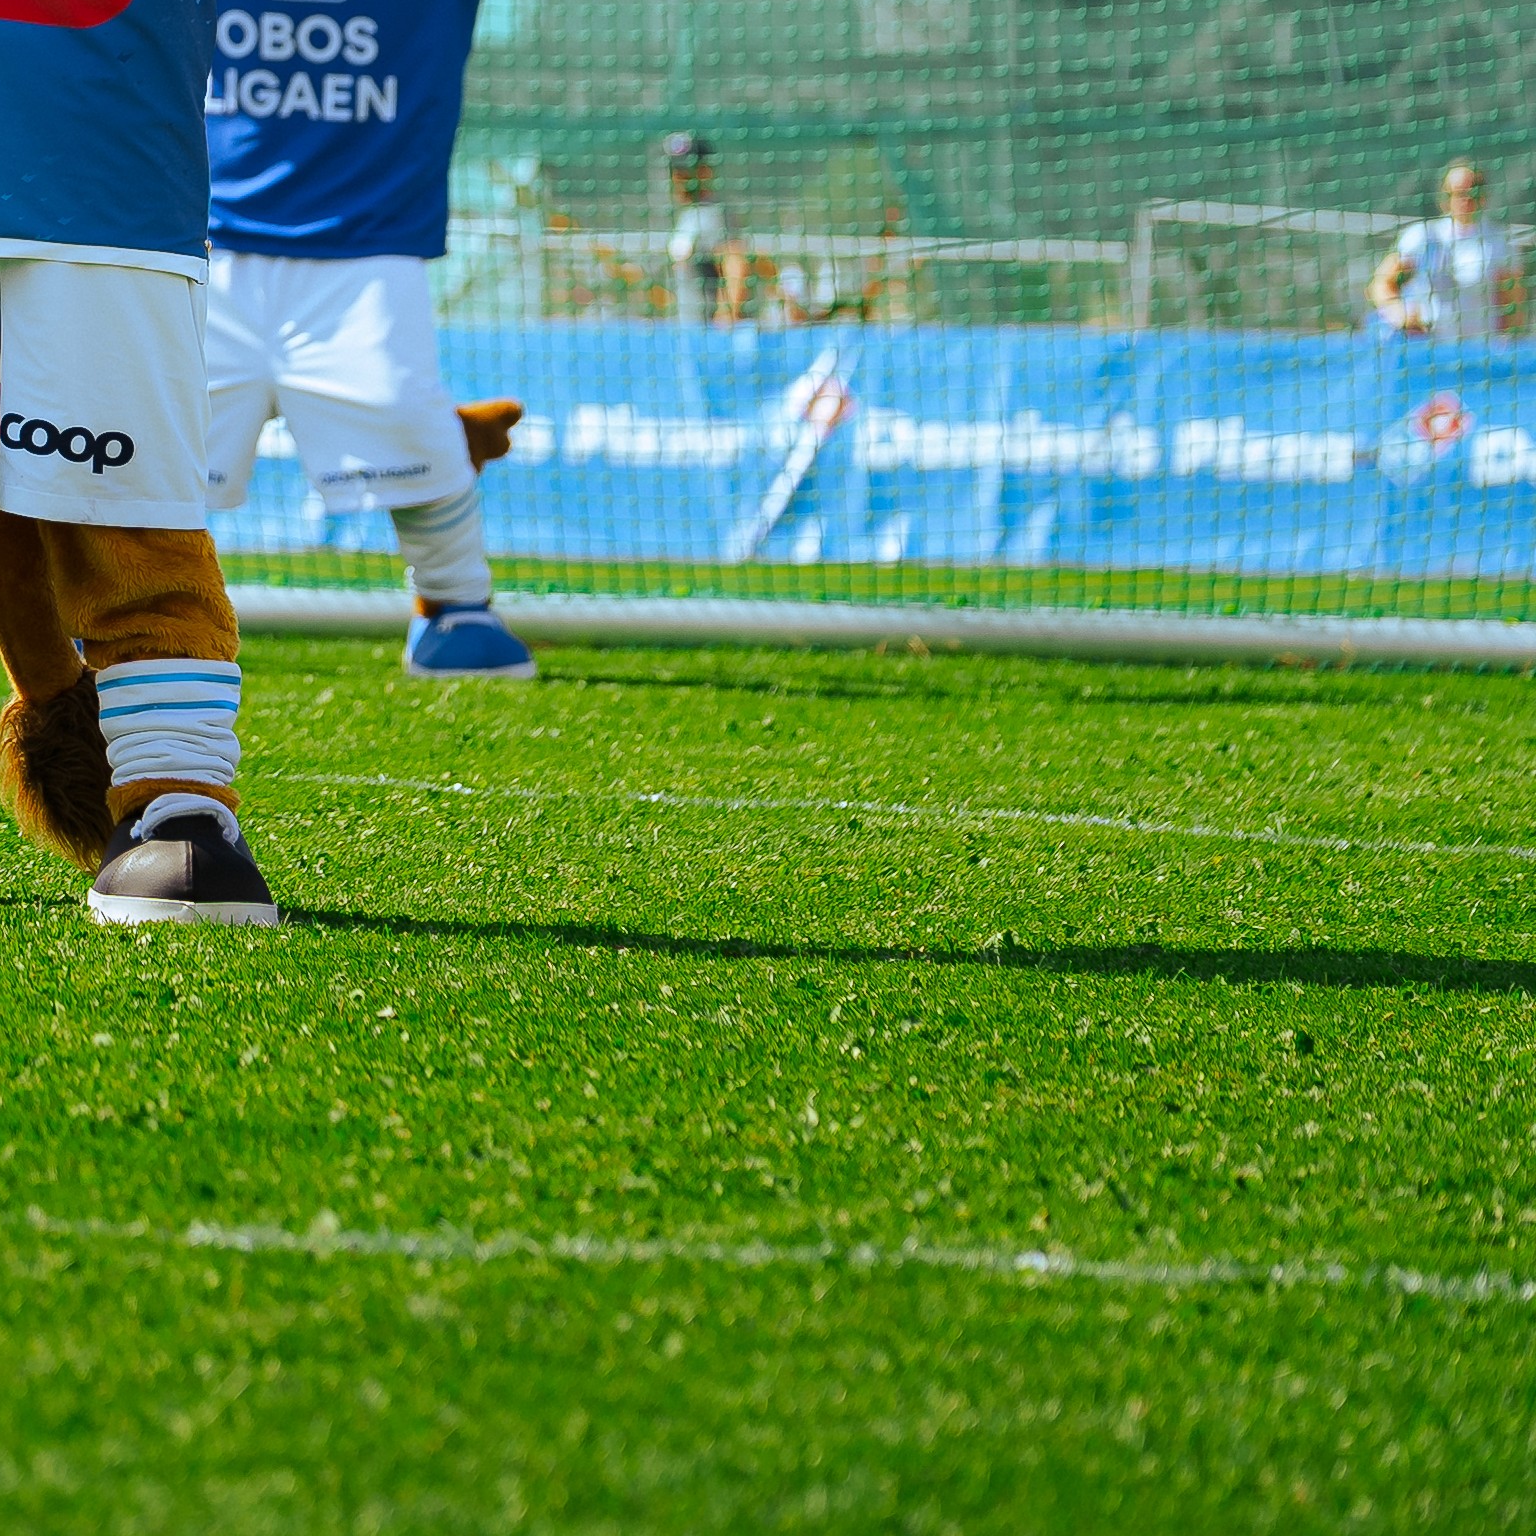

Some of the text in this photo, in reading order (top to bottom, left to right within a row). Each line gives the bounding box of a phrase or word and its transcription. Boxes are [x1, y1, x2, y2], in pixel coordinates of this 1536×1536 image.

[216, 8, 379, 66] OBOS
[204, 66, 398, 123] LIGAEN
[0, 412, 136, 476] coop
